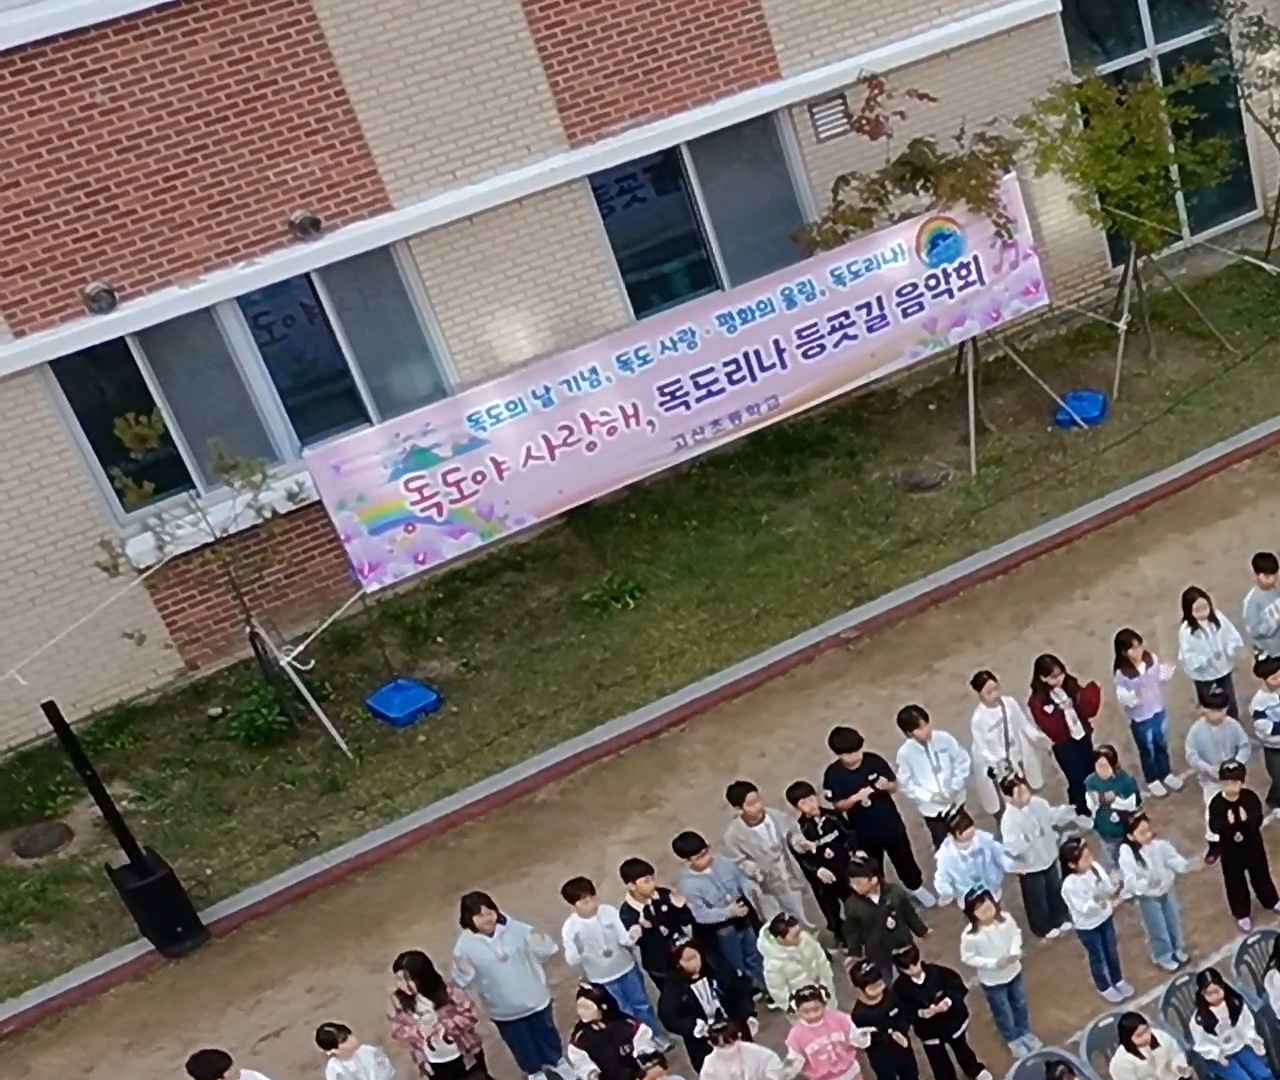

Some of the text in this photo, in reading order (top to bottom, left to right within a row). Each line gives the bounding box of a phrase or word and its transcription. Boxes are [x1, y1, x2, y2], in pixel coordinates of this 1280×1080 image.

[403, 254, 986, 519] 독도야 사랑해, 독도리나 등굣길 음악회
[466, 396, 527, 432] 독도의
[531, 385, 555, 408] 날
[615, 345, 654, 374] 독도
[660, 326, 698, 355] 사랑
[715, 297, 776, 334] 평화의
[671, 394, 780, 452] 고산초등학교
